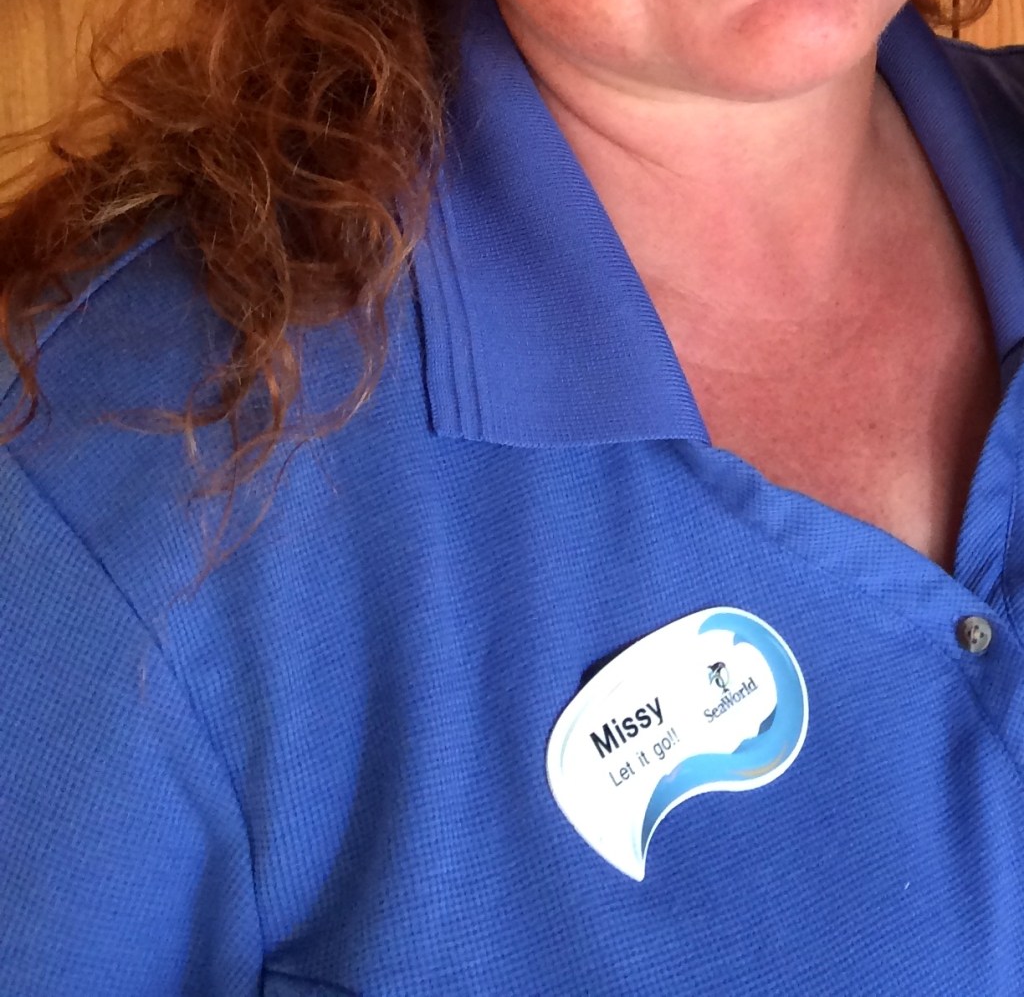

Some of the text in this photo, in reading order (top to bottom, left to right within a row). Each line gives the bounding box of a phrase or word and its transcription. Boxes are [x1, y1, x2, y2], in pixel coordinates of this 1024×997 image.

[589, 696, 664, 759] Missy
[703, 676, 758, 723] SeaWorld
[608, 727, 680, 787] Let it go!!
